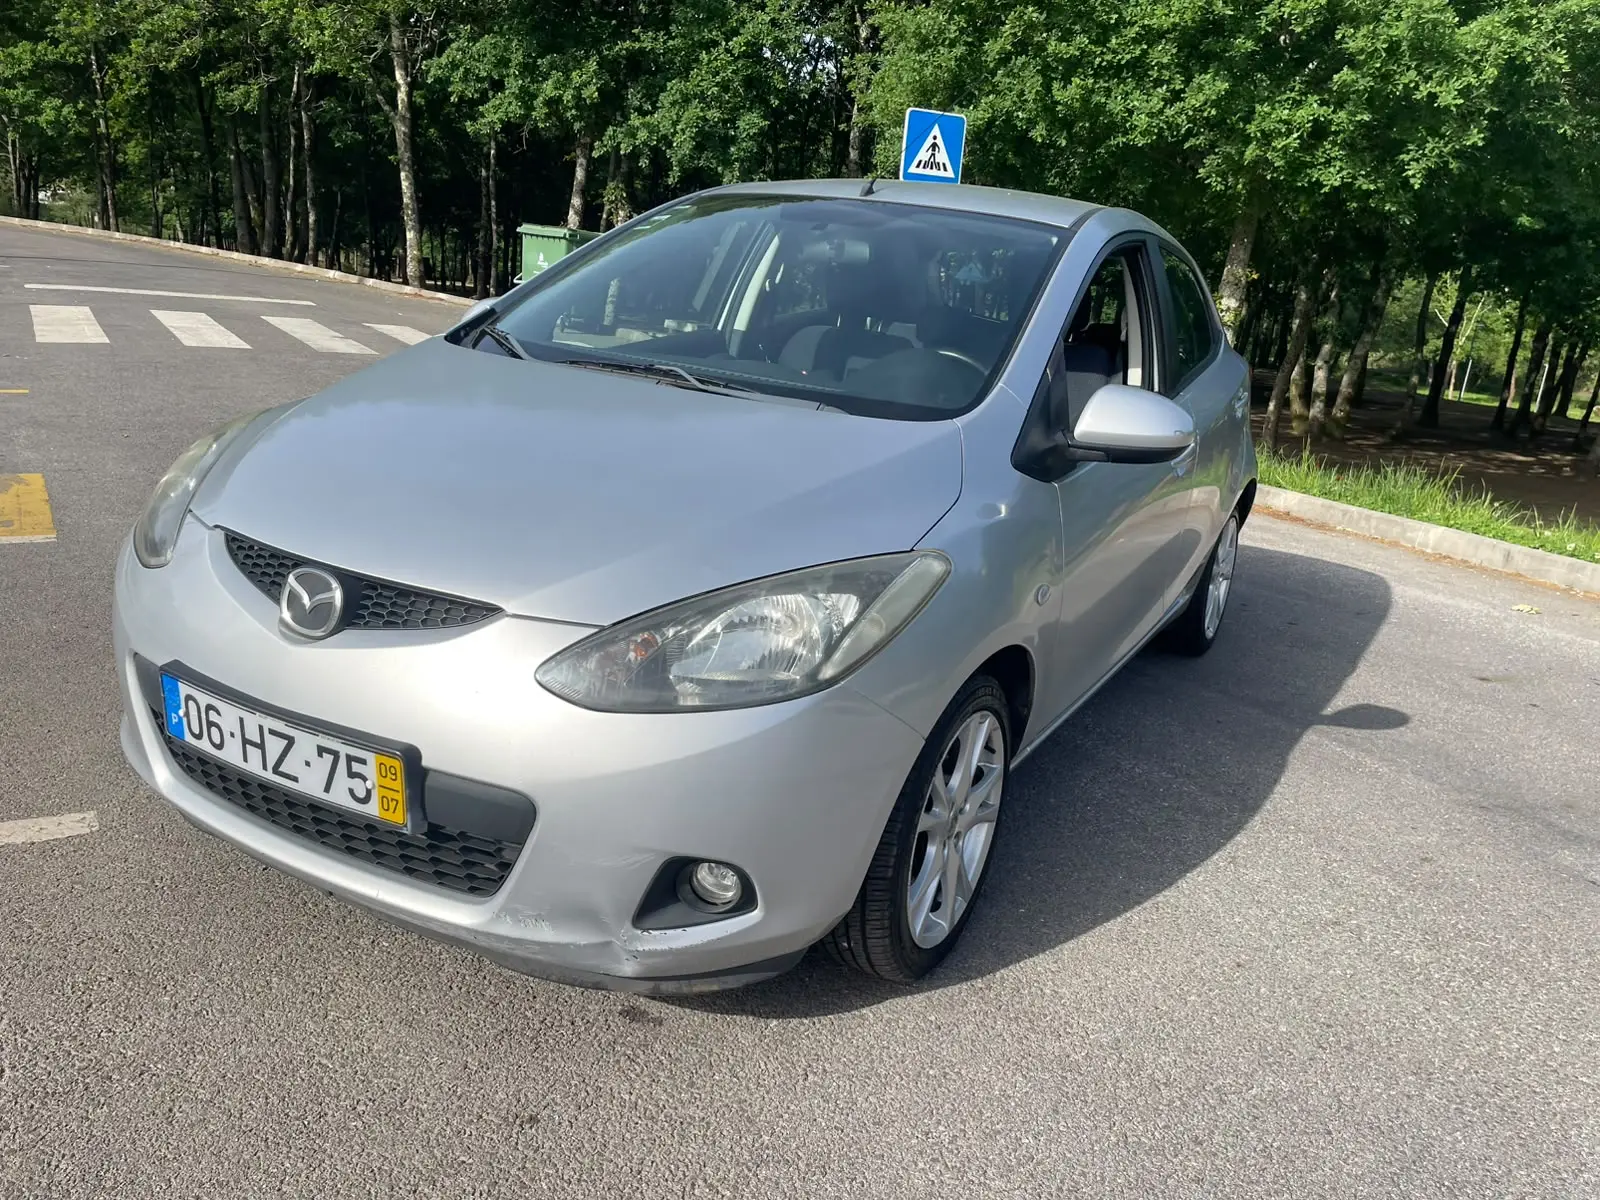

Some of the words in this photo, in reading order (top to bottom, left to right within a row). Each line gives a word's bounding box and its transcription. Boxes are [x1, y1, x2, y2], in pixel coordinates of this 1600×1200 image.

[171, 711, 179, 725] P
[379, 761, 398, 782] 09
[381, 795, 399, 814] 07
